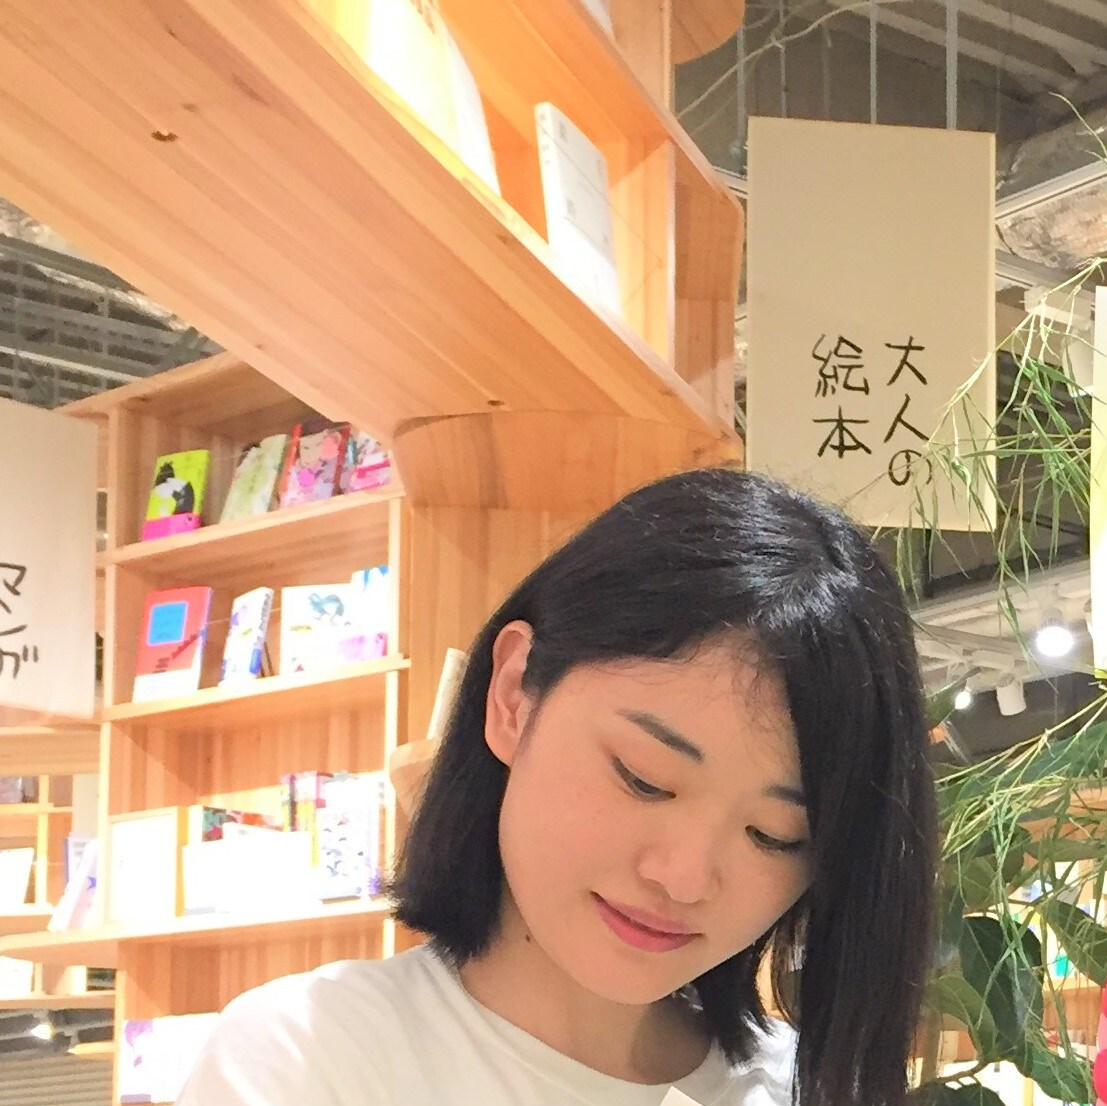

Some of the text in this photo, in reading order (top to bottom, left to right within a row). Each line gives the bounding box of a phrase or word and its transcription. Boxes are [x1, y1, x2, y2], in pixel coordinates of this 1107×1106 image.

[811, 333, 872, 460] 絵本
[885, 335, 933, 487] 大人の
